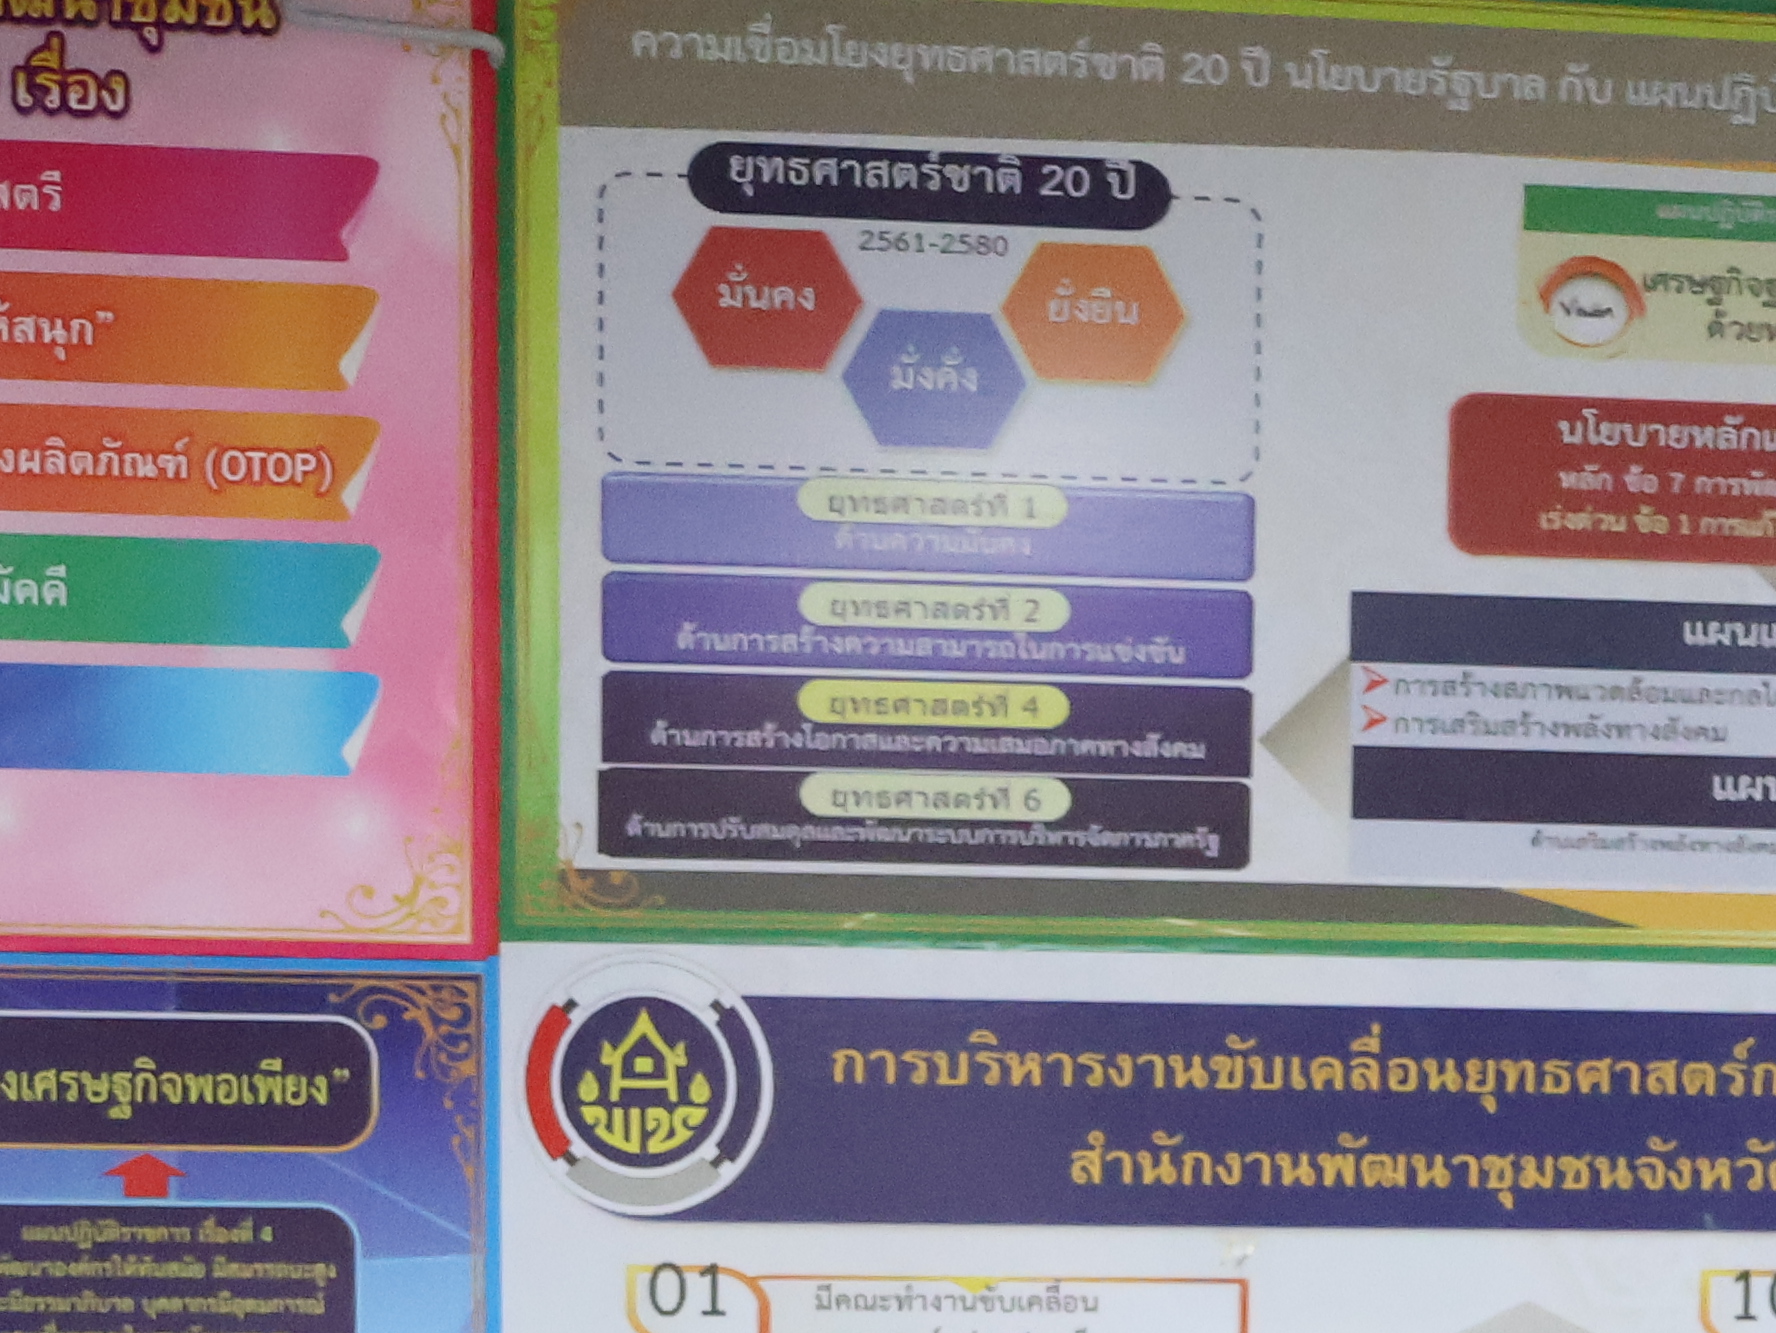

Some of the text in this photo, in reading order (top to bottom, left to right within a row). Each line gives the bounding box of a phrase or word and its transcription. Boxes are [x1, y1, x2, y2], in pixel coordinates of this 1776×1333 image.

[12, 41, 132, 118] เรื่อง
[630, 24, 1166, 88] ความเชื่อมโยงยุทธศาสตร์ชาติ
[1180, 51, 1226, 86] 20
[1240, 44, 1268, 89] ปี
[1282, 50, 1546, 112] นโยบายรัฐบาล
[1558, 62, 1613, 107] กับ
[727, 148, 1137, 202] ยุทธศาสตร์ชาติ 20 ปี
[717, 264, 818, 314] มั่นคง
[1046, 278, 1141, 327] ยั่งยืน
[204, 447, 335, 493] (OTOP)
[1026, 498, 1037, 520] 1
[1023, 599, 1040, 625] 2
[1021, 696, 1040, 720] 4
[1025, 786, 1042, 812] 6
[648, 1263, 726, 1318] 01
[815, 1281, 1099, 1315] มีคณะทำงานขับเคลื่อน
